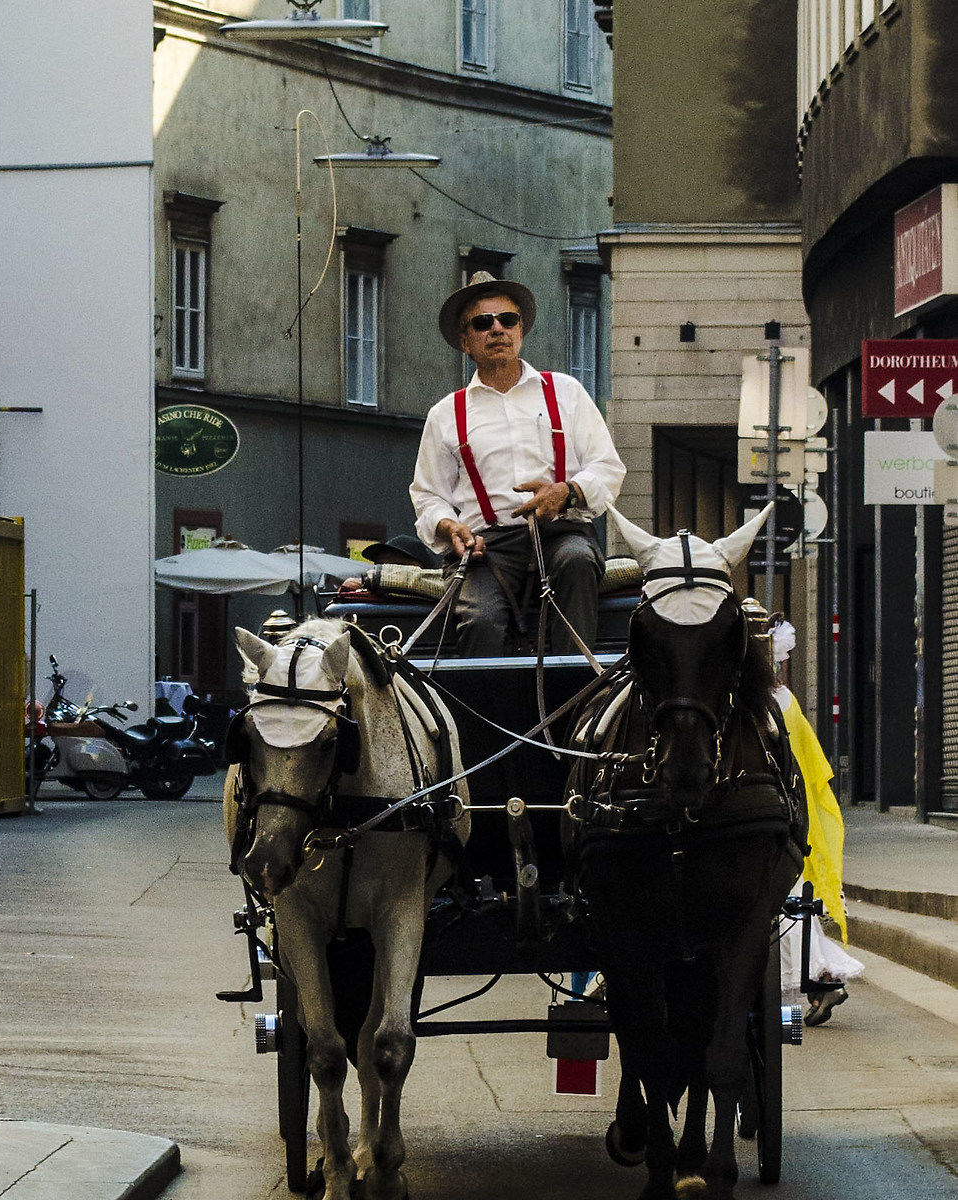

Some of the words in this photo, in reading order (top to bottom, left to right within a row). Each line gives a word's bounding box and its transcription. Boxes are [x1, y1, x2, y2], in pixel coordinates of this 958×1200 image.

[183, 410, 203, 420] CHE
[203, 413, 224, 429] RIDE
[894, 487, 935, 499] bouti
